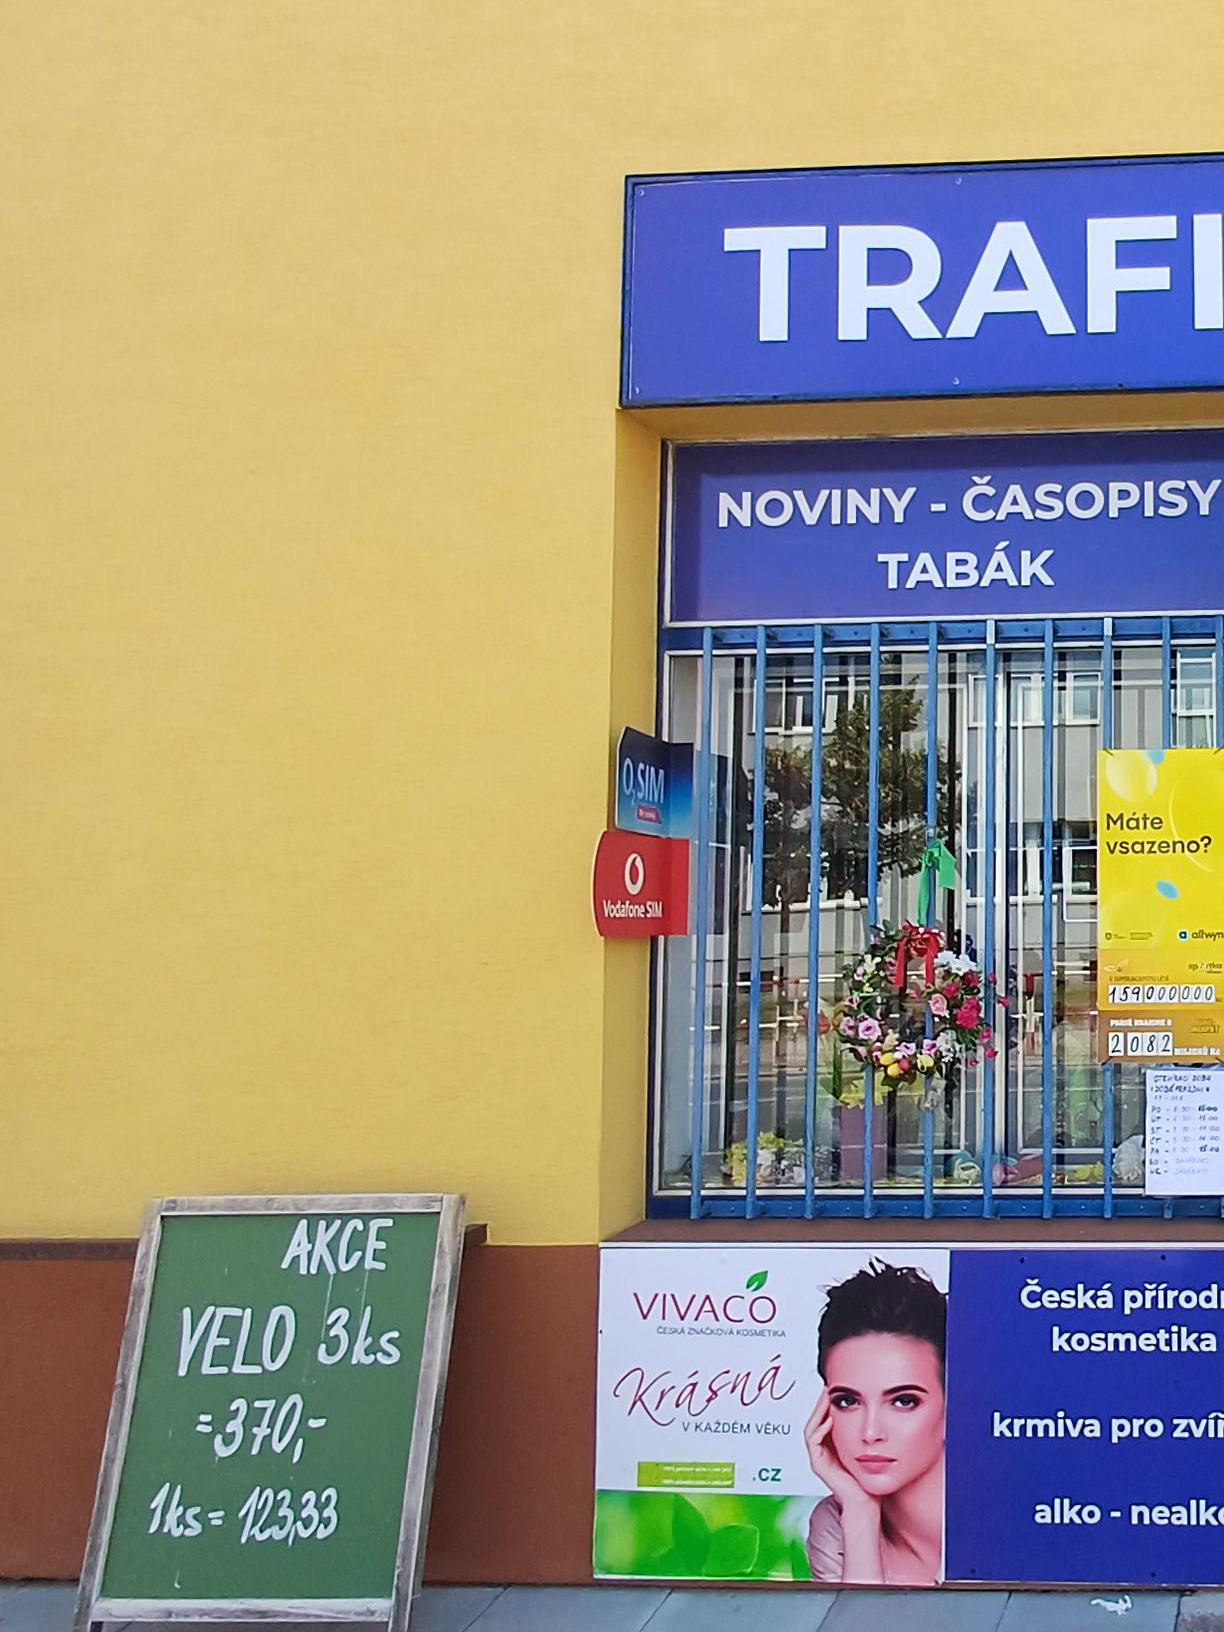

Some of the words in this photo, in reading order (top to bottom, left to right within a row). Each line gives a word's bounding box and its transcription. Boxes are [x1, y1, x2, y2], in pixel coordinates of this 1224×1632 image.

[717, 486, 918, 529] NOVINY
[961, 474, 1223, 524] ČASOPISY
[876, 540, 1056, 590] TABÁK
[636, 761, 665, 804] SIM
[1105, 811, 1164, 832] Máte
[1105, 835, 1213, 855] vsazeno?
[602, 899, 645, 918] Vodafone
[646, 900, 663, 918] SIM
[1191, 929, 1224, 942] allwyn
[280, 1218, 394, 1275] AKCE
[633, 1291, 777, 1324] VIVACO
[1020, 1278, 1114, 1309] Česká
[177, 1305, 296, 1377] VELO
[317, 1305, 401, 1365] 3ks
[656, 1326, 686, 1336] ČESKÁ
[736, 1328, 786, 1338] KOSMETIKA
[1052, 1325, 1218, 1352] kosmetika
[613, 1354, 796, 1427] Krásná
[682, 1421, 690, 1433] V
[693, 1419, 751, 1435] KAŽDÉM
[754, 1419, 792, 1435] VĚKU
[993, 1410, 1101, 1438] krmiva
[1111, 1417, 1164, 1444] pro
[1034, 1497, 1102, 1524] alko
